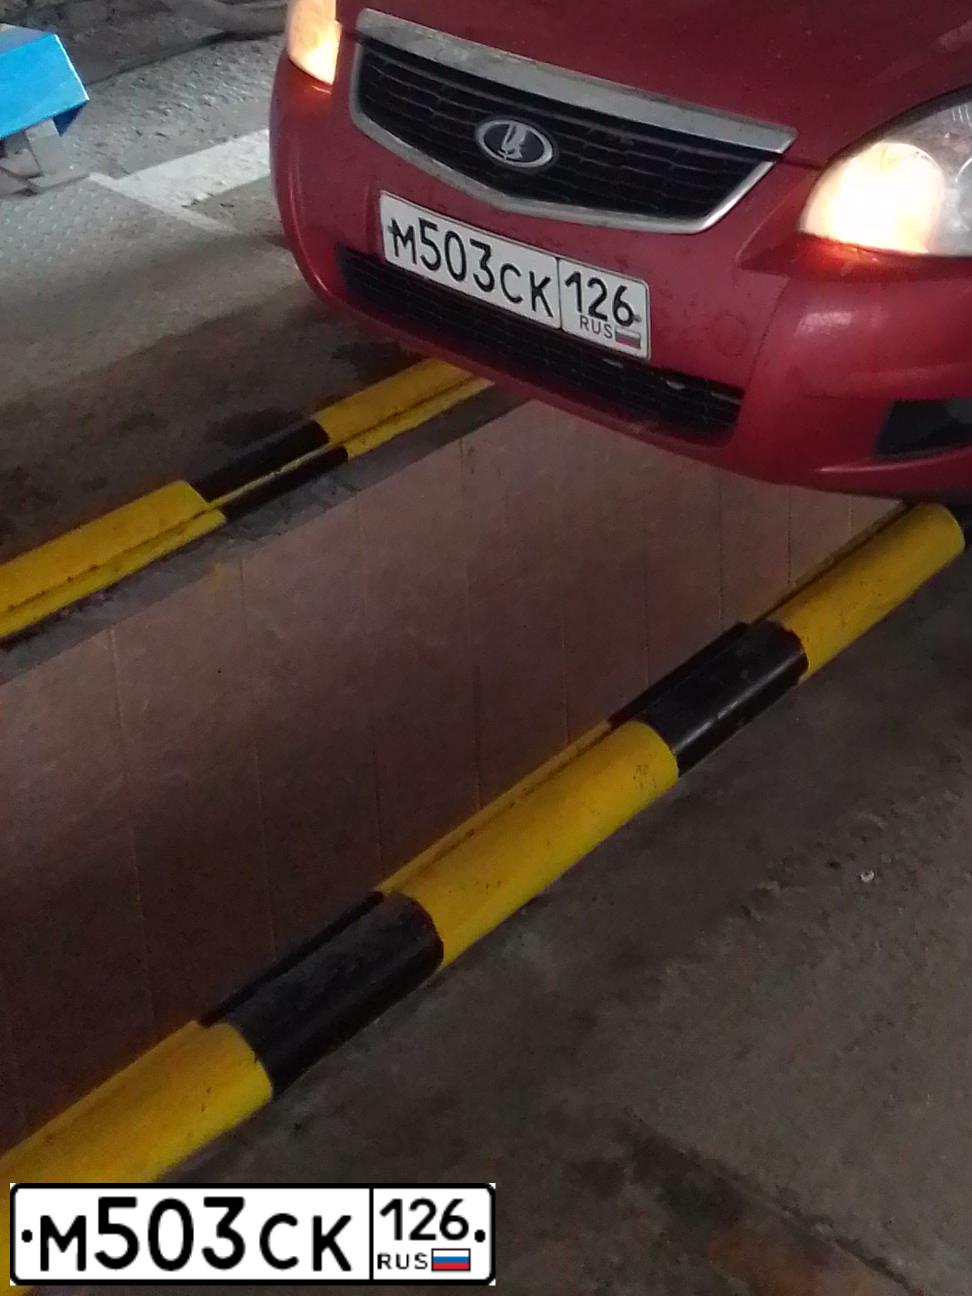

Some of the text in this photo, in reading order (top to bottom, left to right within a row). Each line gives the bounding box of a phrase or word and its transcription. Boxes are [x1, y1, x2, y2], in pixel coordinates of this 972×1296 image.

[390, 217, 635, 328] М503СК 126
[579, 314, 613, 339] RUS
